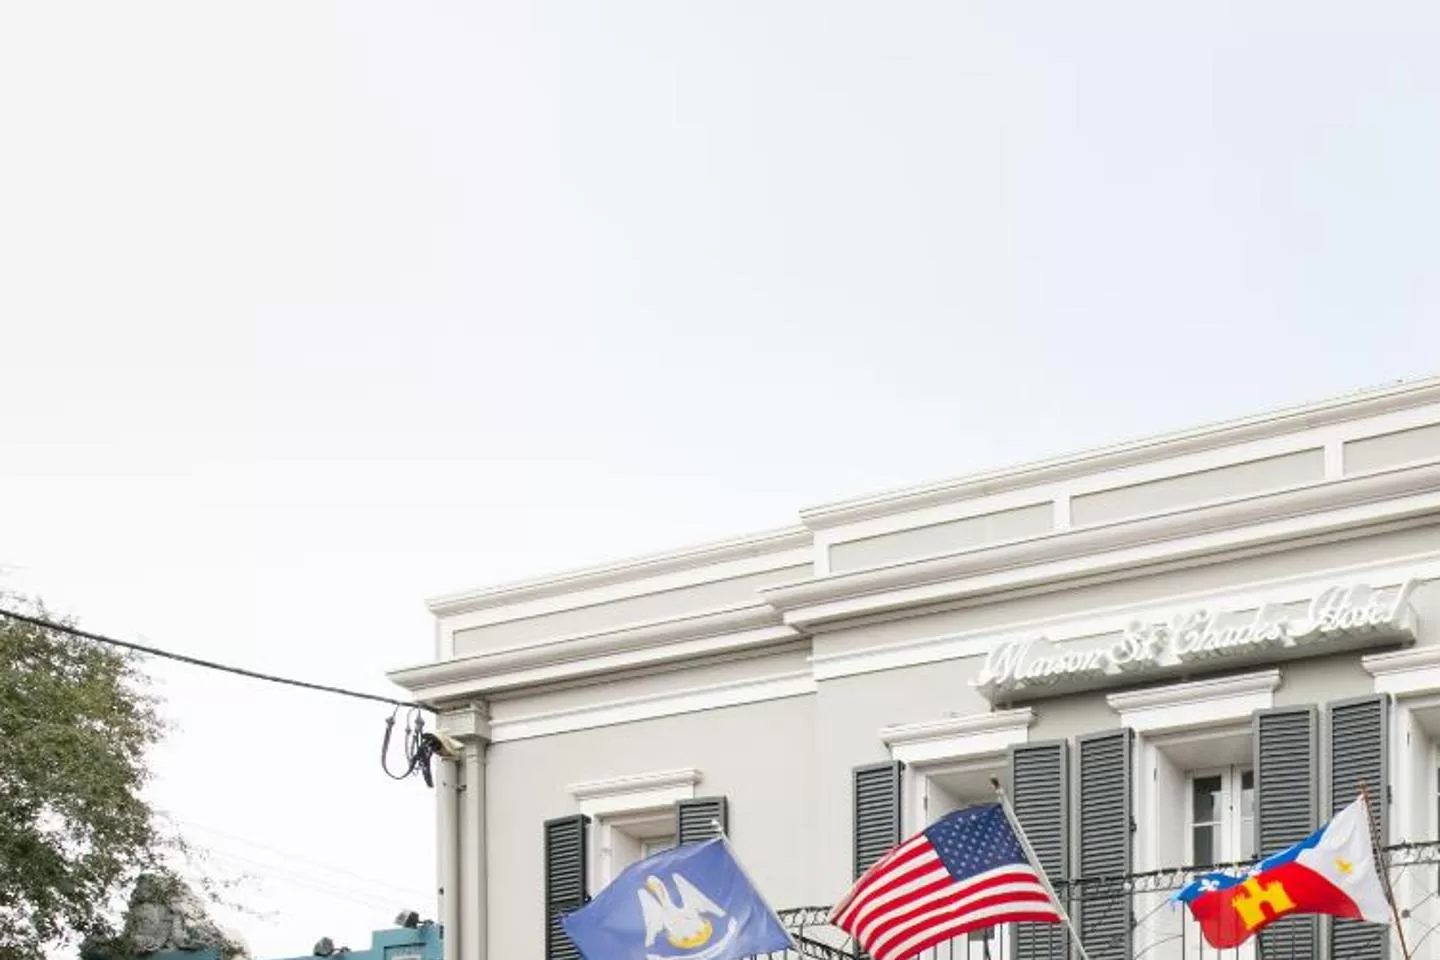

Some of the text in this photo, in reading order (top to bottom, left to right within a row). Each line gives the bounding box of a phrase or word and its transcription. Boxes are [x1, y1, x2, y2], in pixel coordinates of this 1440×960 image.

[970, 635, 1105, 684] Maison
[1166, 602, 1289, 660] Charles
[1300, 578, 1415, 636] Hotel
